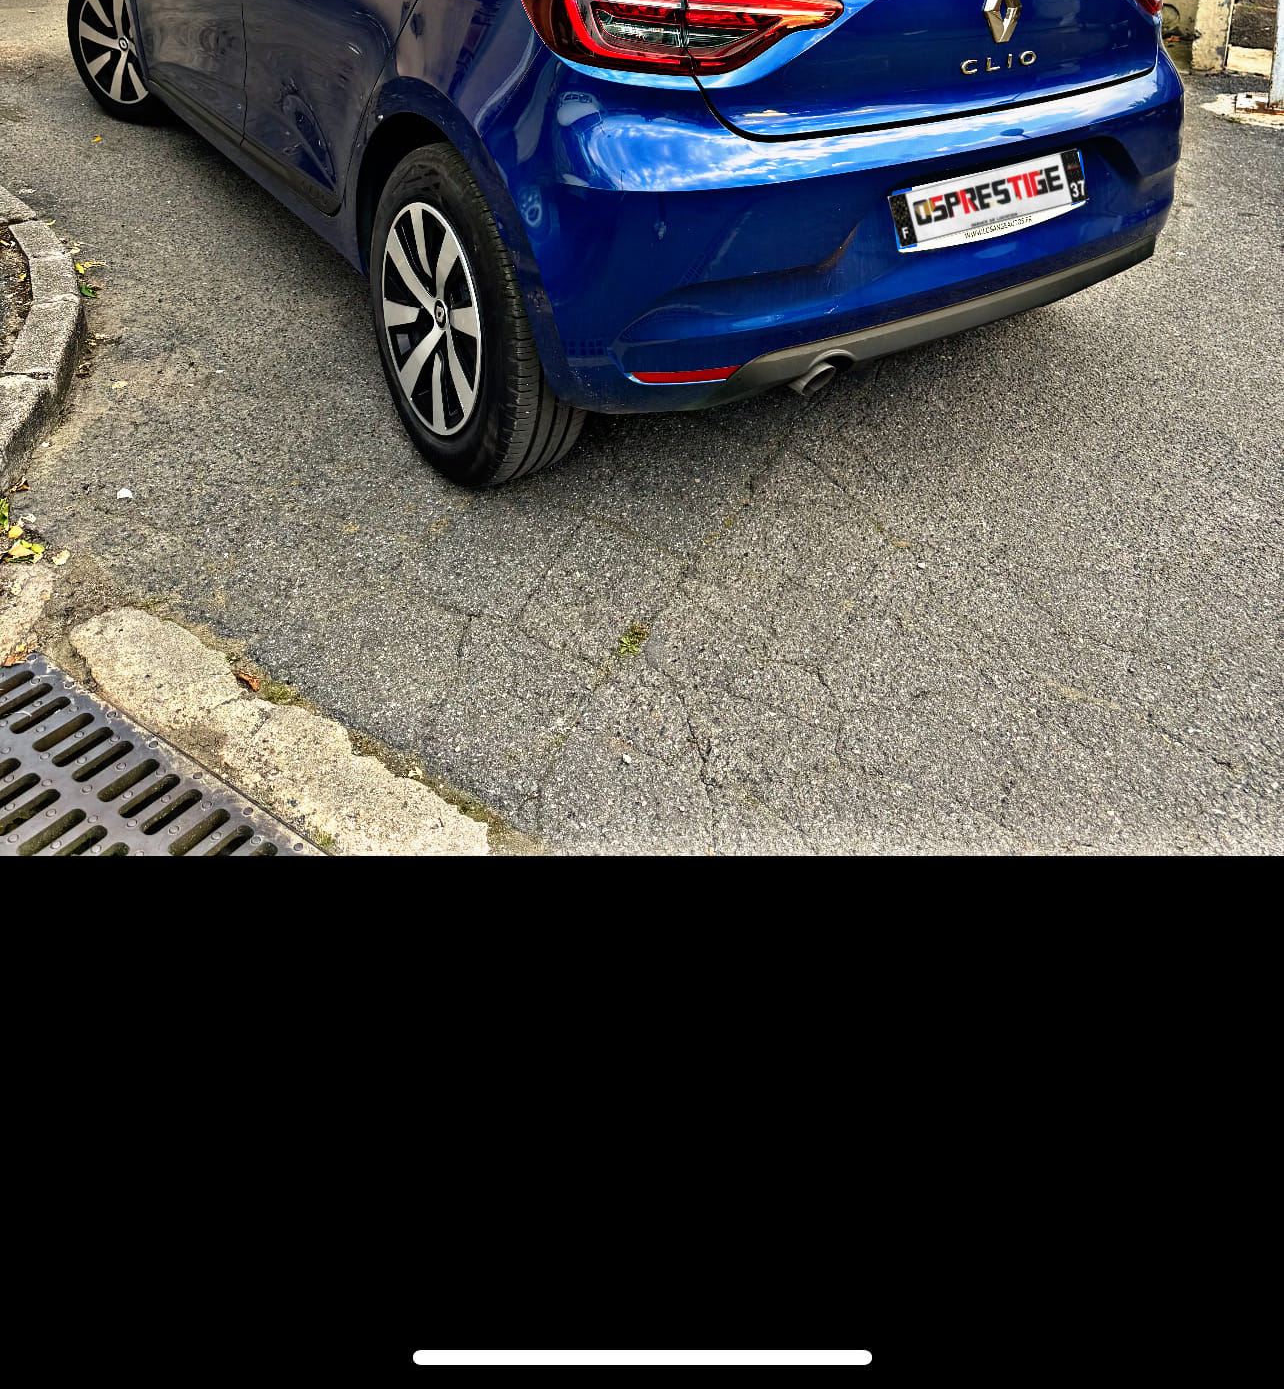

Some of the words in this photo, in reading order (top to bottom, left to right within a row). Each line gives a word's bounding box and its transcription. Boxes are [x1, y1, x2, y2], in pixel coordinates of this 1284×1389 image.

[961, 51, 1036, 75] CLIO
[1070, 180, 1085, 198] 37
[901, 226, 910, 239] F
